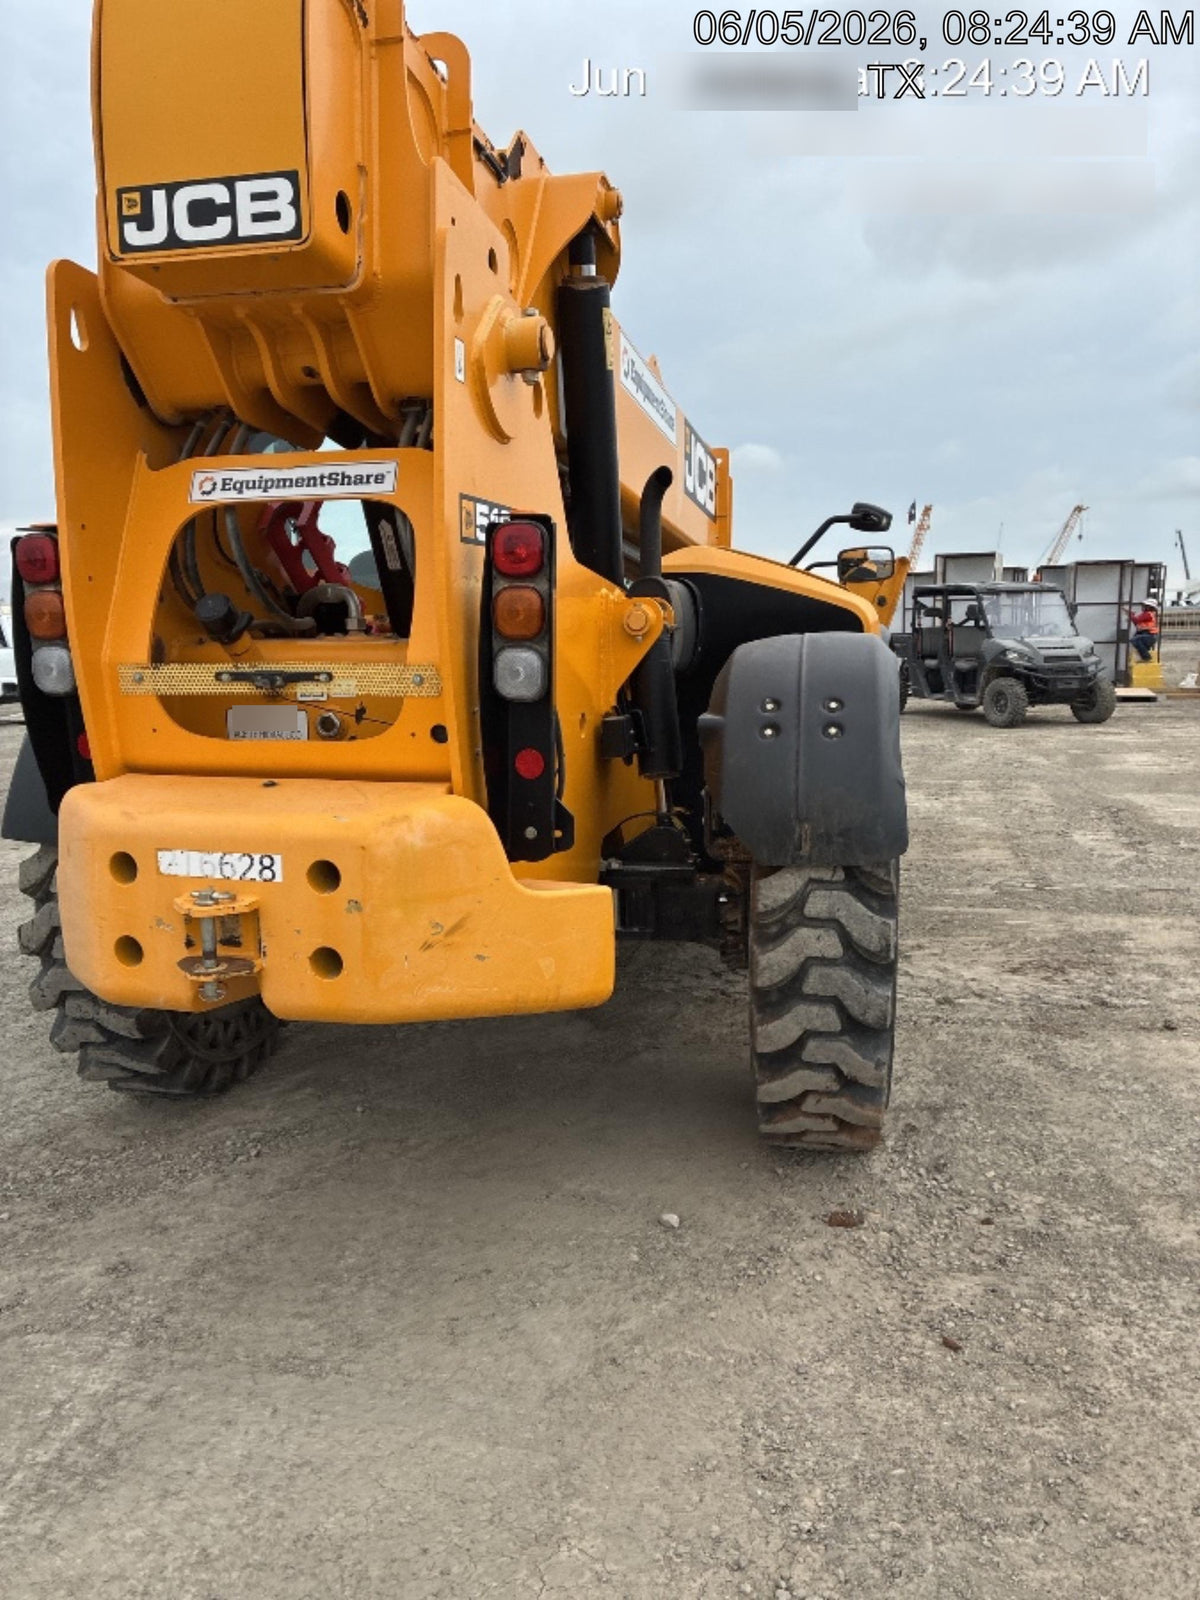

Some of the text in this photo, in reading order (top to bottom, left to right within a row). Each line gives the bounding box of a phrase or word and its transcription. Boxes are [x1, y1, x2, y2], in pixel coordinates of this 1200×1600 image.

[123, 177, 297, 246] JCB
[220, 470, 387, 494] EquipmentShare
[685, 432, 716, 516] JCB
